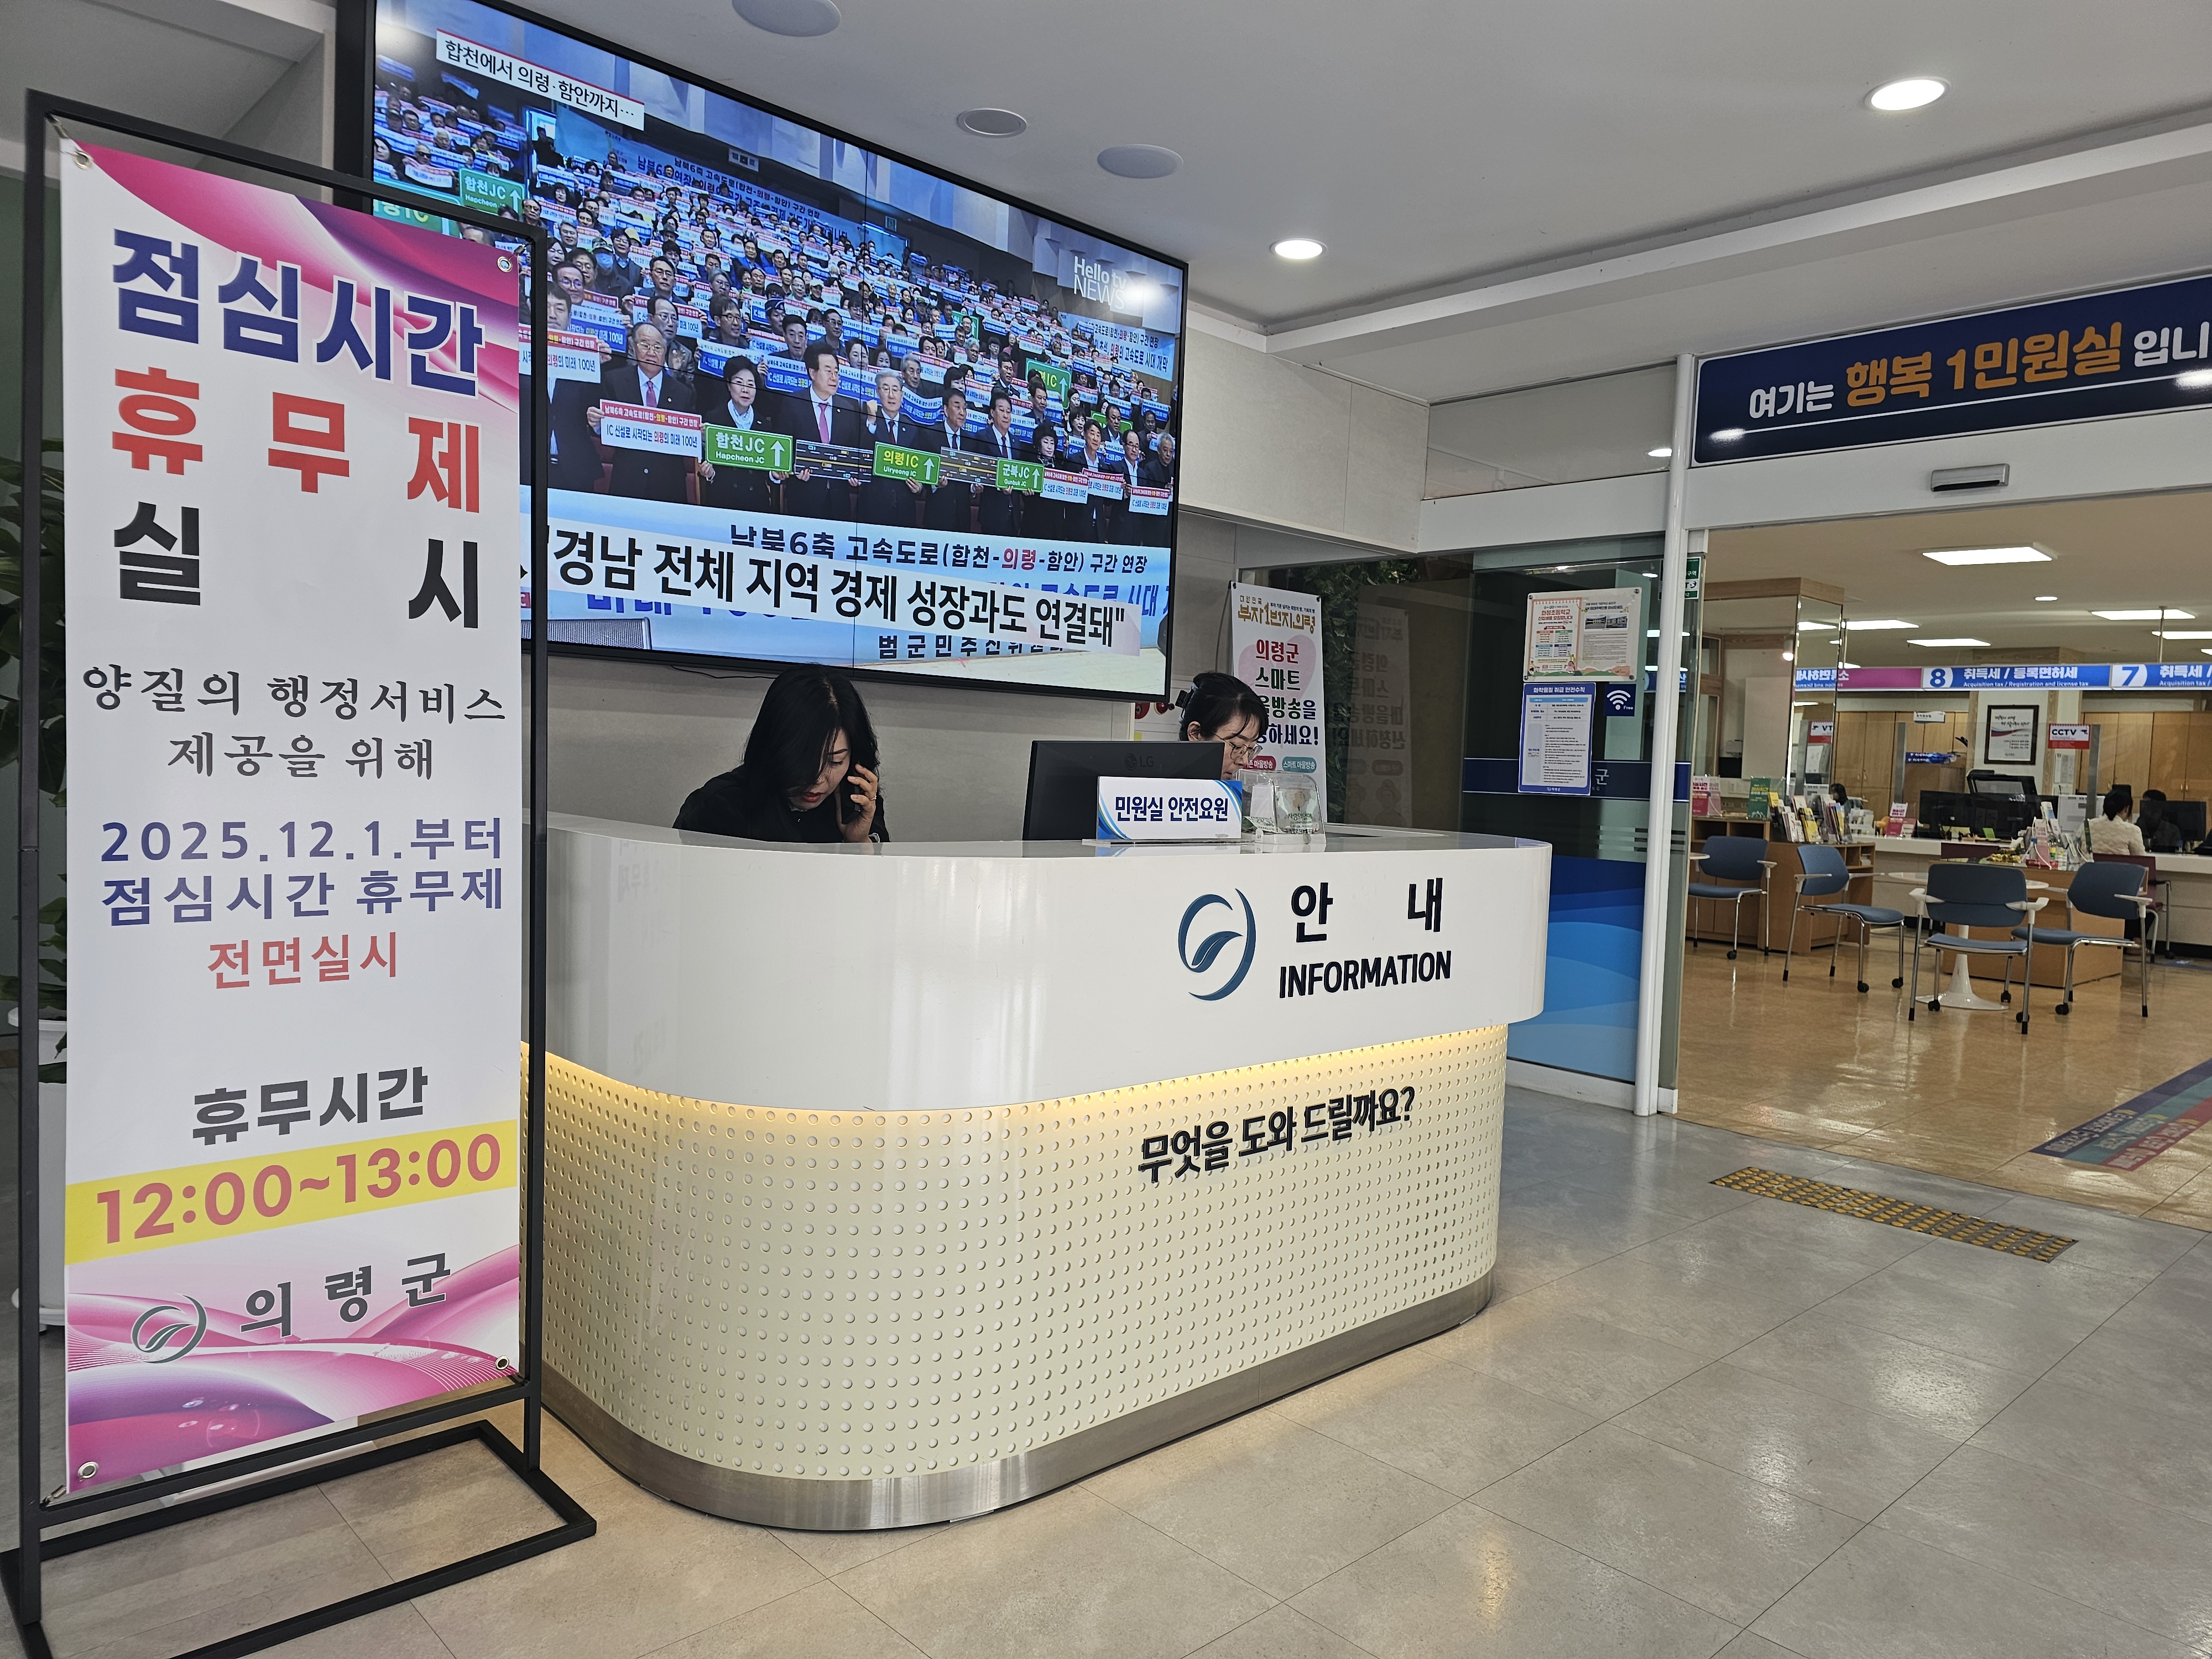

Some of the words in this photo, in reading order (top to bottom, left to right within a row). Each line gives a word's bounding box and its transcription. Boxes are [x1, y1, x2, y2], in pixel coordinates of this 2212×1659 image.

[445, 39, 513, 80] 합천에서
[1074, 255, 1110, 284] Hello
[1111, 272, 1126, 289] tv
[1073, 274, 1125, 310] NEWS
[112, 228, 483, 396] 점심시간
[609, 331, 623, 345] 100년
[578, 358, 596, 372] 100년
[1124, 347, 1144, 365] 고속도로
[1145, 352, 1156, 369] 시대
[1749, 380, 1835, 419] 여기는
[1846, 351, 1933, 406] 행복
[1947, 321, 2122, 391] 1민원실
[607, 424, 614, 432] IC
[615, 424, 631, 439] 신설로
[632, 427, 653, 442] 시작되는
[654, 430, 669, 445] 의령의
[670, 434, 681, 446] 미래
[681, 435, 698, 448] 100년
[715, 451, 754, 463] Hapcheon
[754, 455, 765, 465] JC
[1089, 554, 1118, 573] 구간
[1122, 555, 1147, 574] 연장
[547, 525, 643, 591] 경남
[654, 544, 734, 603] 전체
[747, 559, 818, 613] 지역
[831, 568, 898, 622] 경제
[906, 580, 1027, 634] 성장과도
[1035, 597, 1125, 648] 연결돼"
[1255, 639, 1299, 664] 의령군
[1255, 667, 1301, 691] 스마트
[1929, 668, 1946, 687] 8
[1964, 667, 2001, 680] 취득세
[2013, 666, 2078, 680] 등록면허세
[2122, 666, 2140, 687] 7
[2159, 665, 2203, 678] 취득세
[82, 664, 241, 716] 양질의
[267, 675, 506, 724] 행정서비스
[167, 732, 326, 778] 제공을
[345, 737, 434, 780] 위해
[1140, 755, 1154, 768] LG
[1254, 760, 1273, 770] 마을방송
[1283, 760, 1297, 769] 스마트
[1297, 760, 1316, 770] 마을방송
[1115, 796, 1163, 822] 민원실
[1167, 796, 1228, 822] 안전요원
[101, 817, 502, 862] 2025.12.1.부터
[101, 872, 335, 927] 점심시간
[356, 868, 503, 915] 휴무제
[207, 932, 397, 989] 전면실시
[1279, 950, 1452, 998] INFORMATION
[192, 1066, 428, 1146] 휴무시간
[1138, 1120, 1232, 1183] 무엇을
[1239, 1106, 1297, 1158] 도와
[1301, 1086, 1415, 1144] 드릴까요?
[96, 1133, 502, 1244] 12:00~13:00
